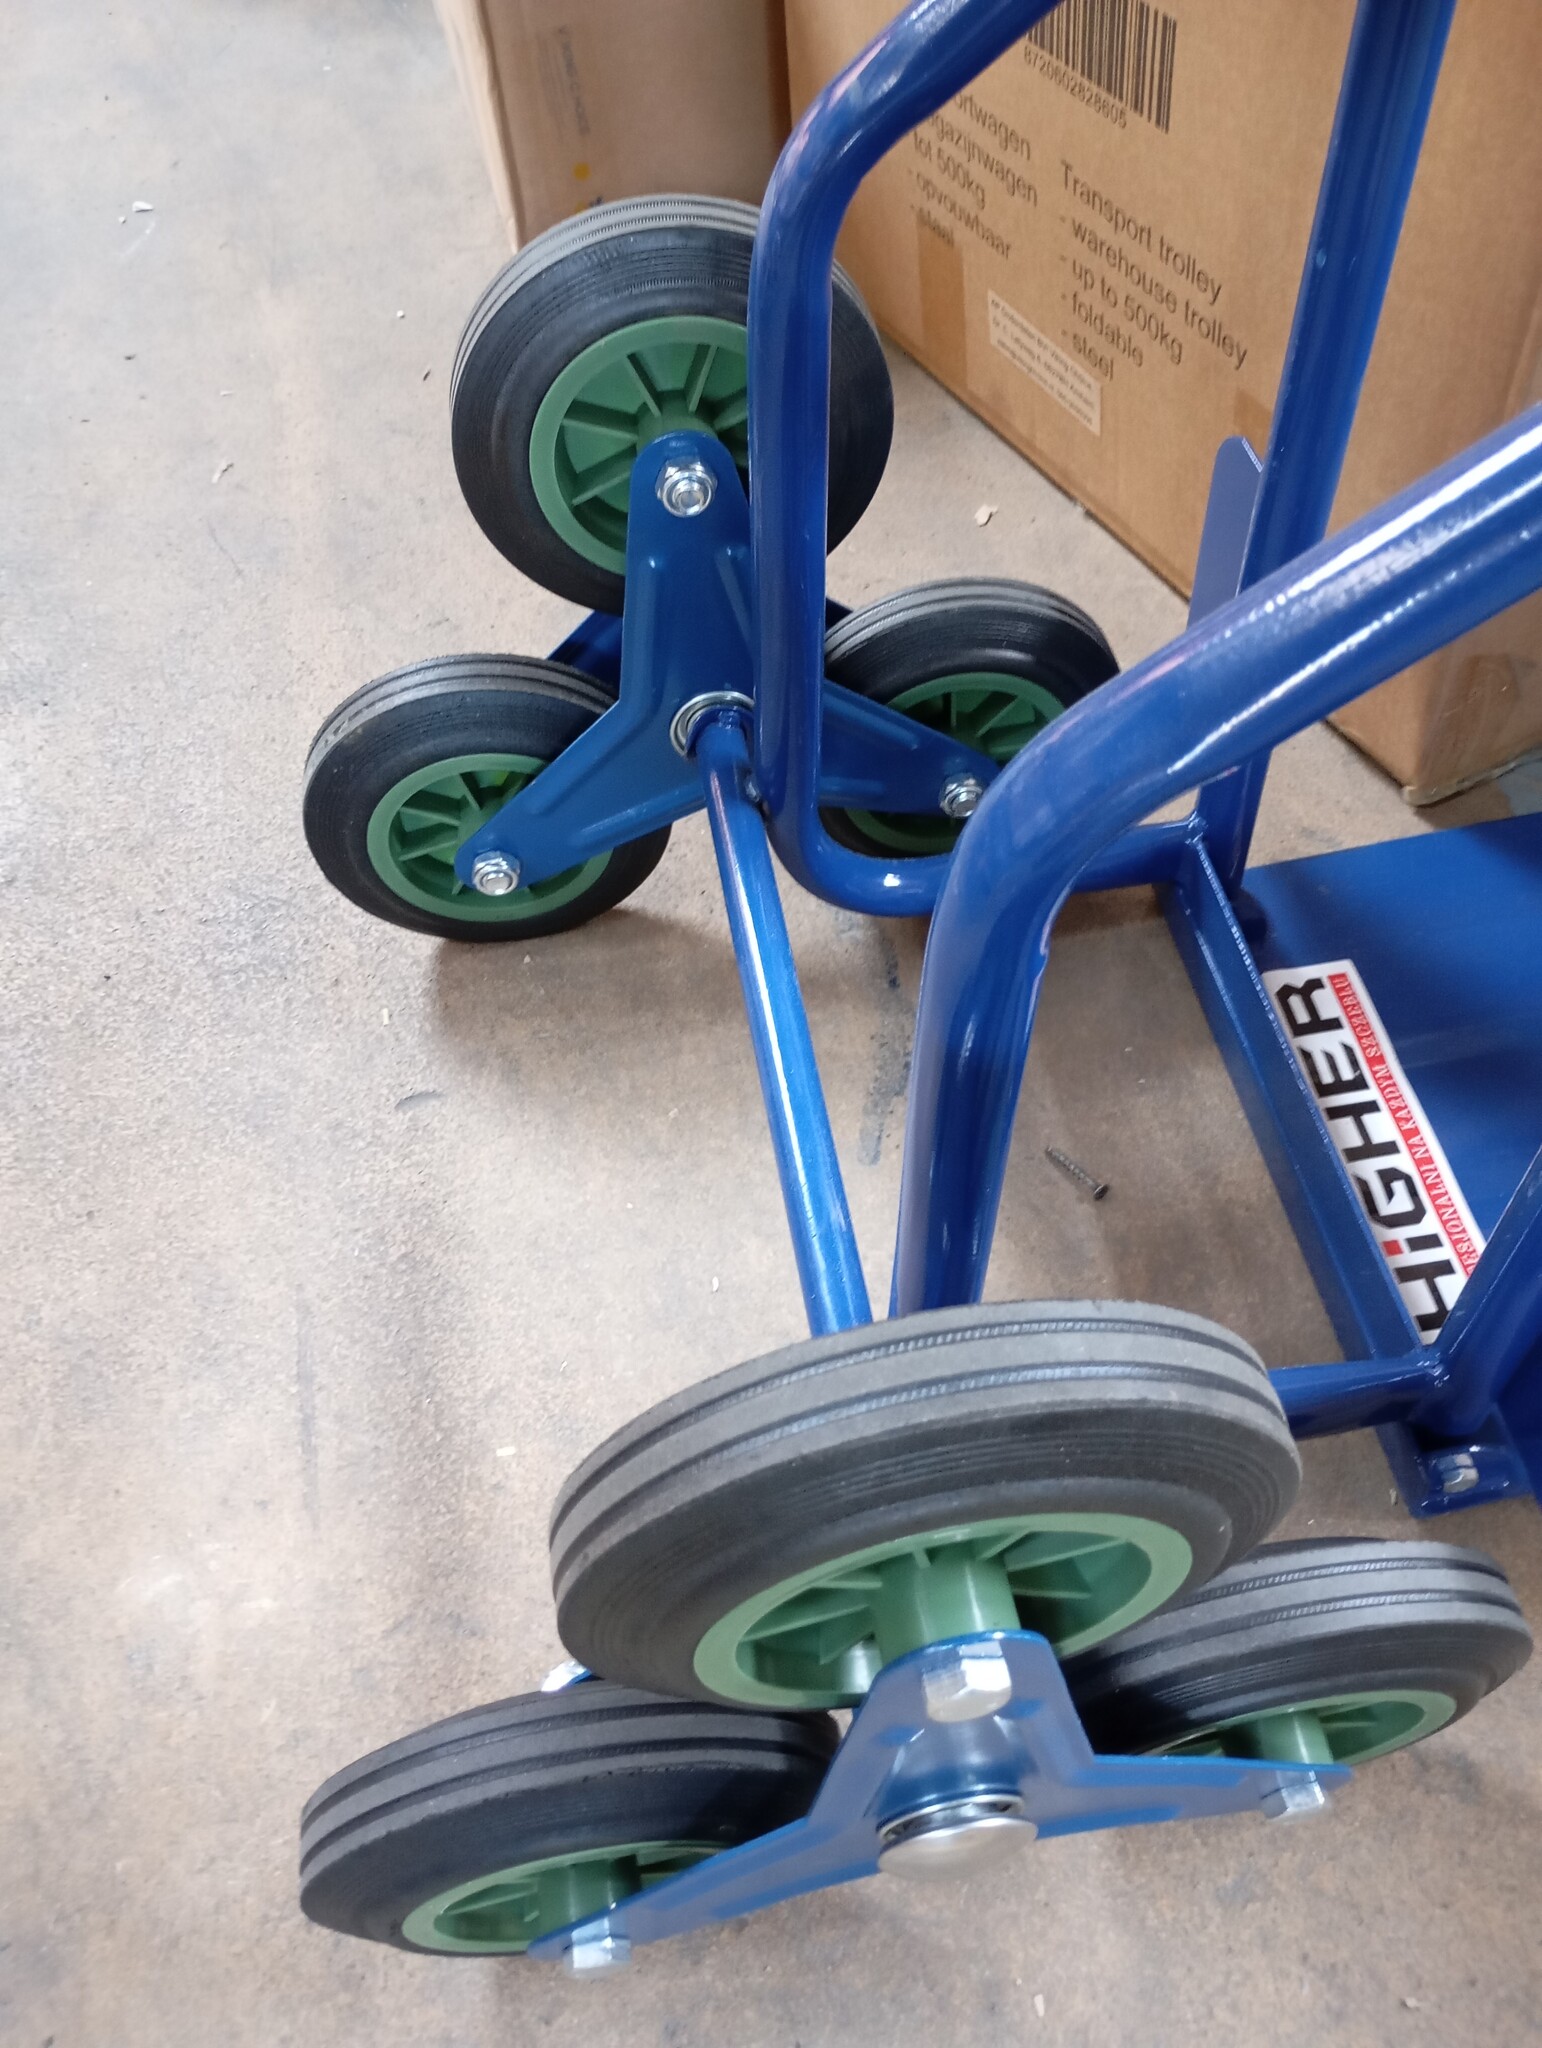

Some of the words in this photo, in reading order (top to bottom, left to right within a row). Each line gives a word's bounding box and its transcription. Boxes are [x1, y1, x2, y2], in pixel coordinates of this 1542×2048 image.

[937, 147, 985, 210] 500kg
[1061, 158, 1152, 252] Transport
[1159, 235, 1222, 306] trolley
[1072, 217, 1177, 313] warehouse
[1185, 299, 1247, 370] trolley
[1072, 259, 1095, 291] up
[1101, 276, 1118, 308] to
[1124, 294, 1183, 365] 500kg
[1072, 291, 1143, 367] foldable
[1072, 333, 1114, 381] steel
[1407, 1136, 1428, 1160] NA
